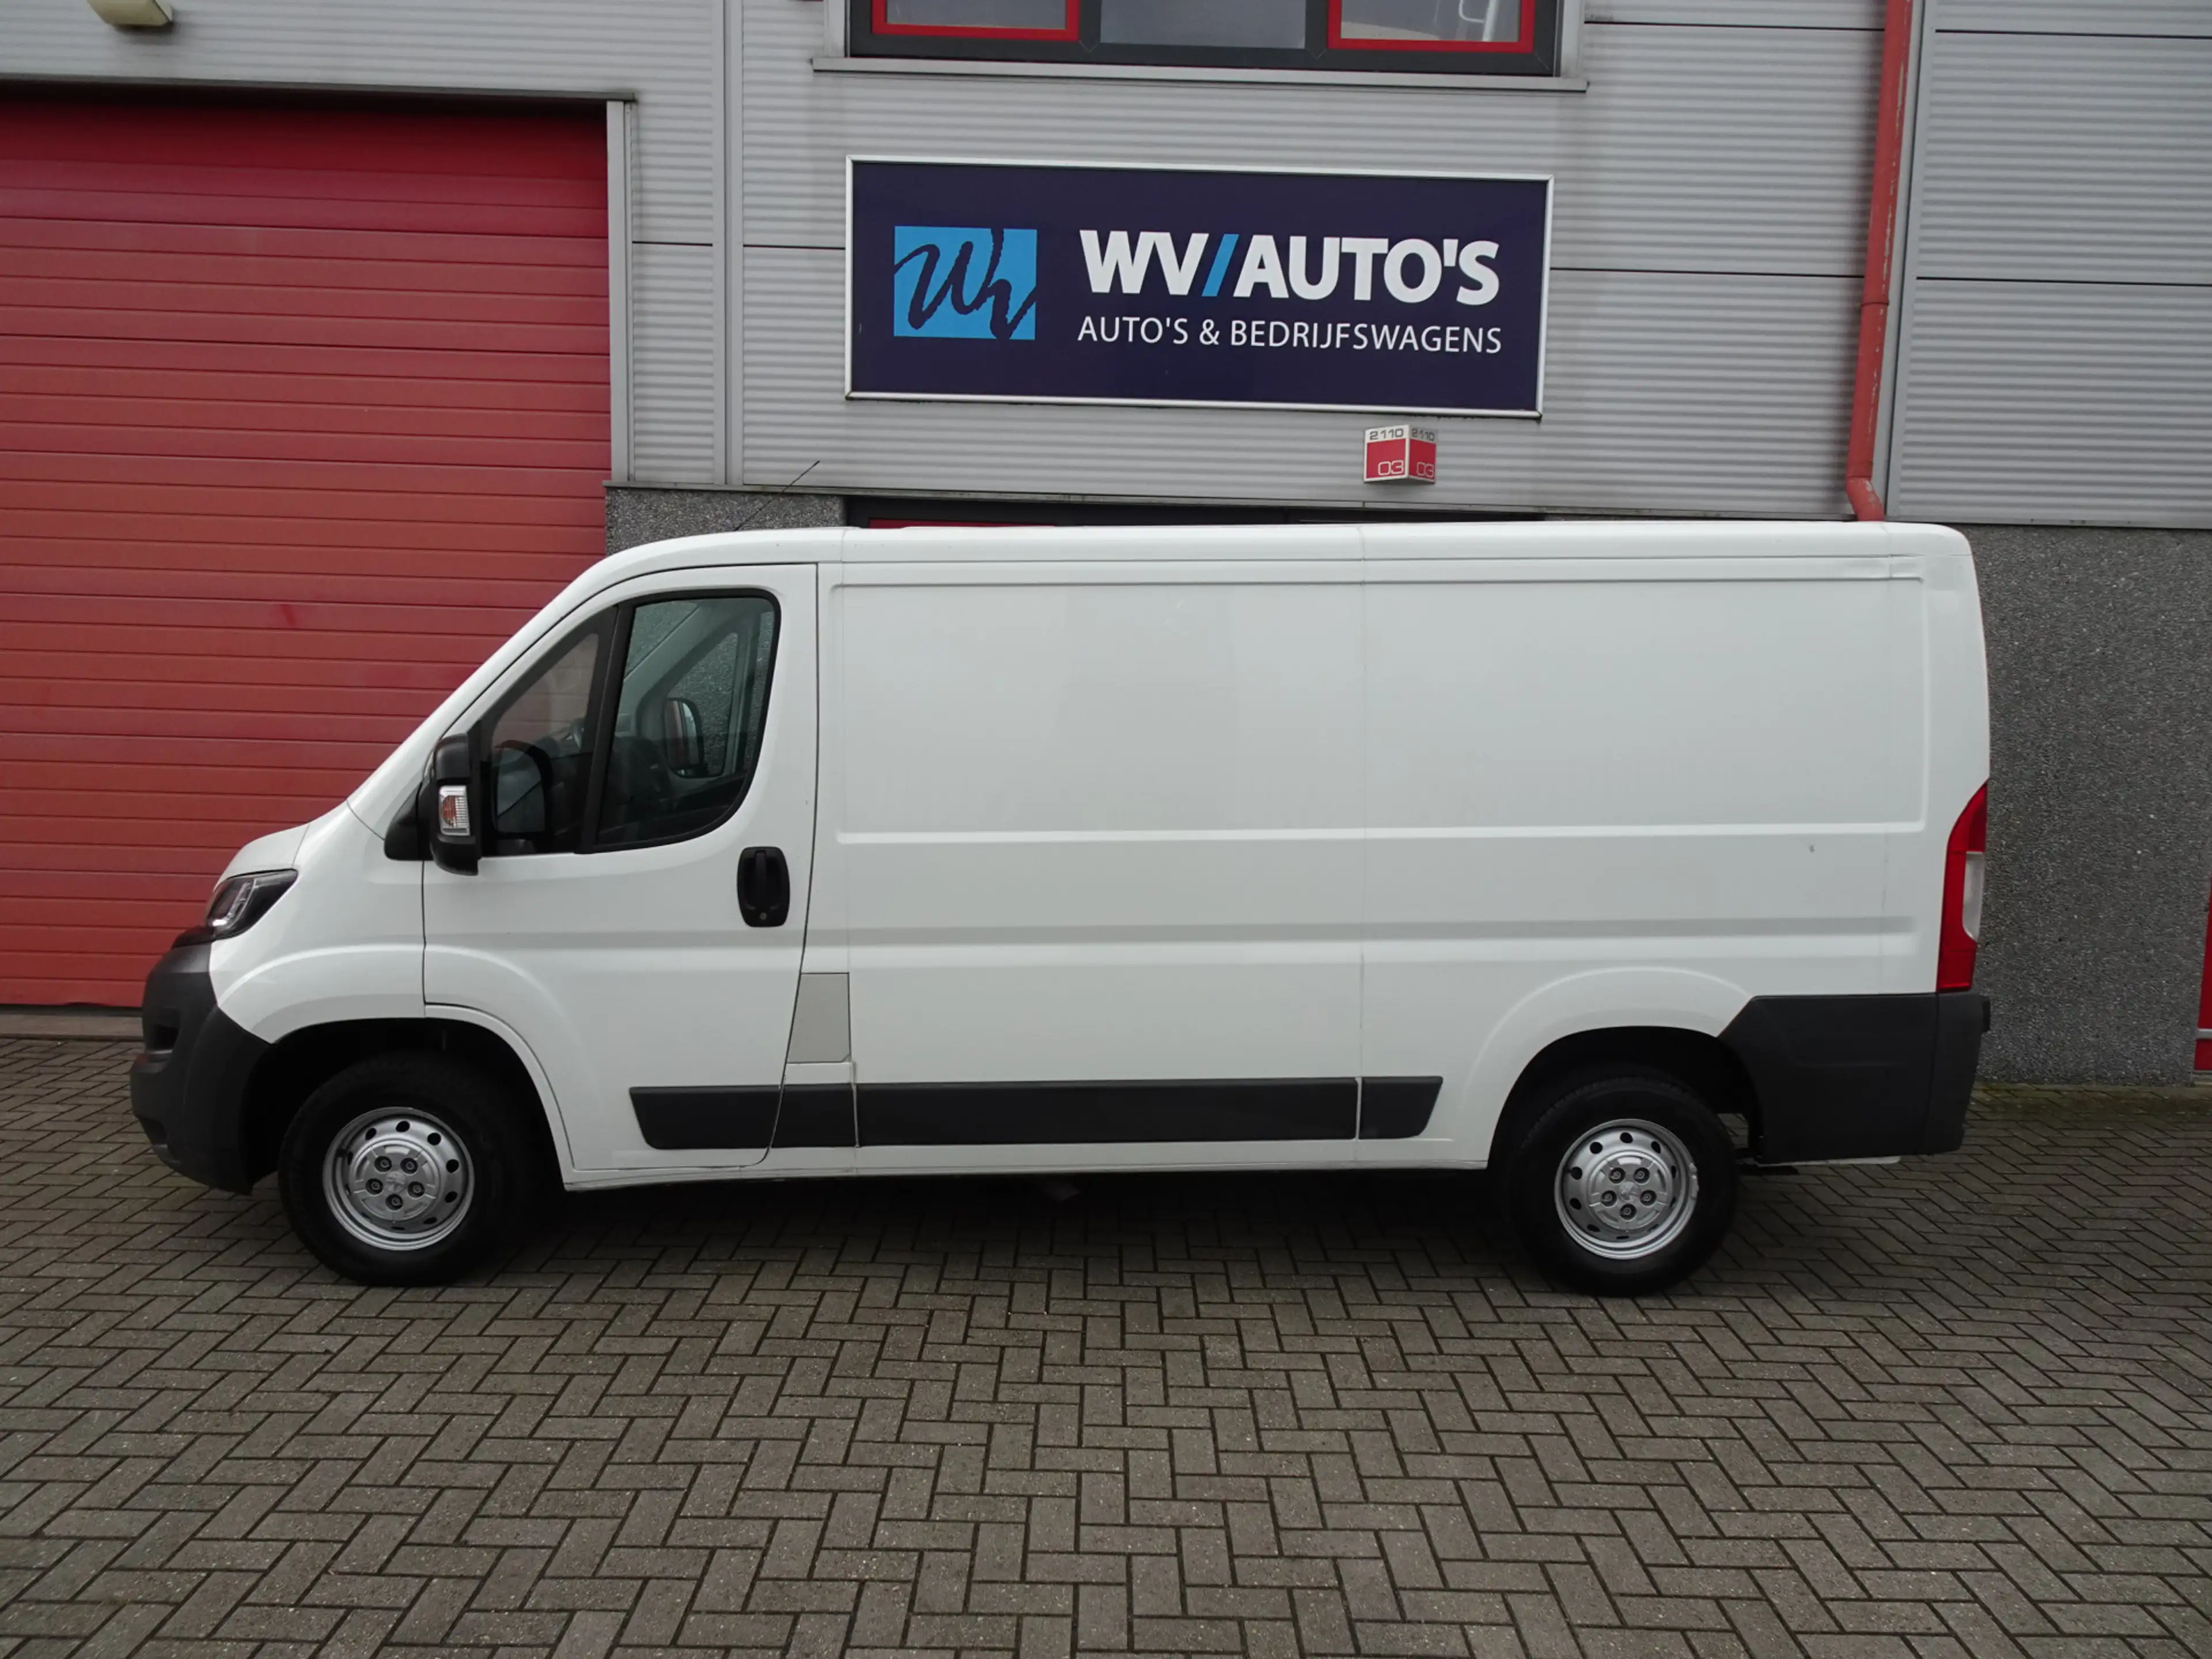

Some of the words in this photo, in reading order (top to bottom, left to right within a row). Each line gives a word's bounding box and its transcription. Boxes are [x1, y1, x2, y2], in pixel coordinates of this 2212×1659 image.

[1077, 316, 1188, 345] AUTO'S
[1199, 319, 1220, 345] &
[1230, 319, 1502, 354] BEDRIJFSWAGENS
[1369, 428, 1404, 441] 2110
[1411, 428, 1435, 441] 2110
[1378, 460, 1404, 476] 03
[1416, 461, 1435, 478] 03
